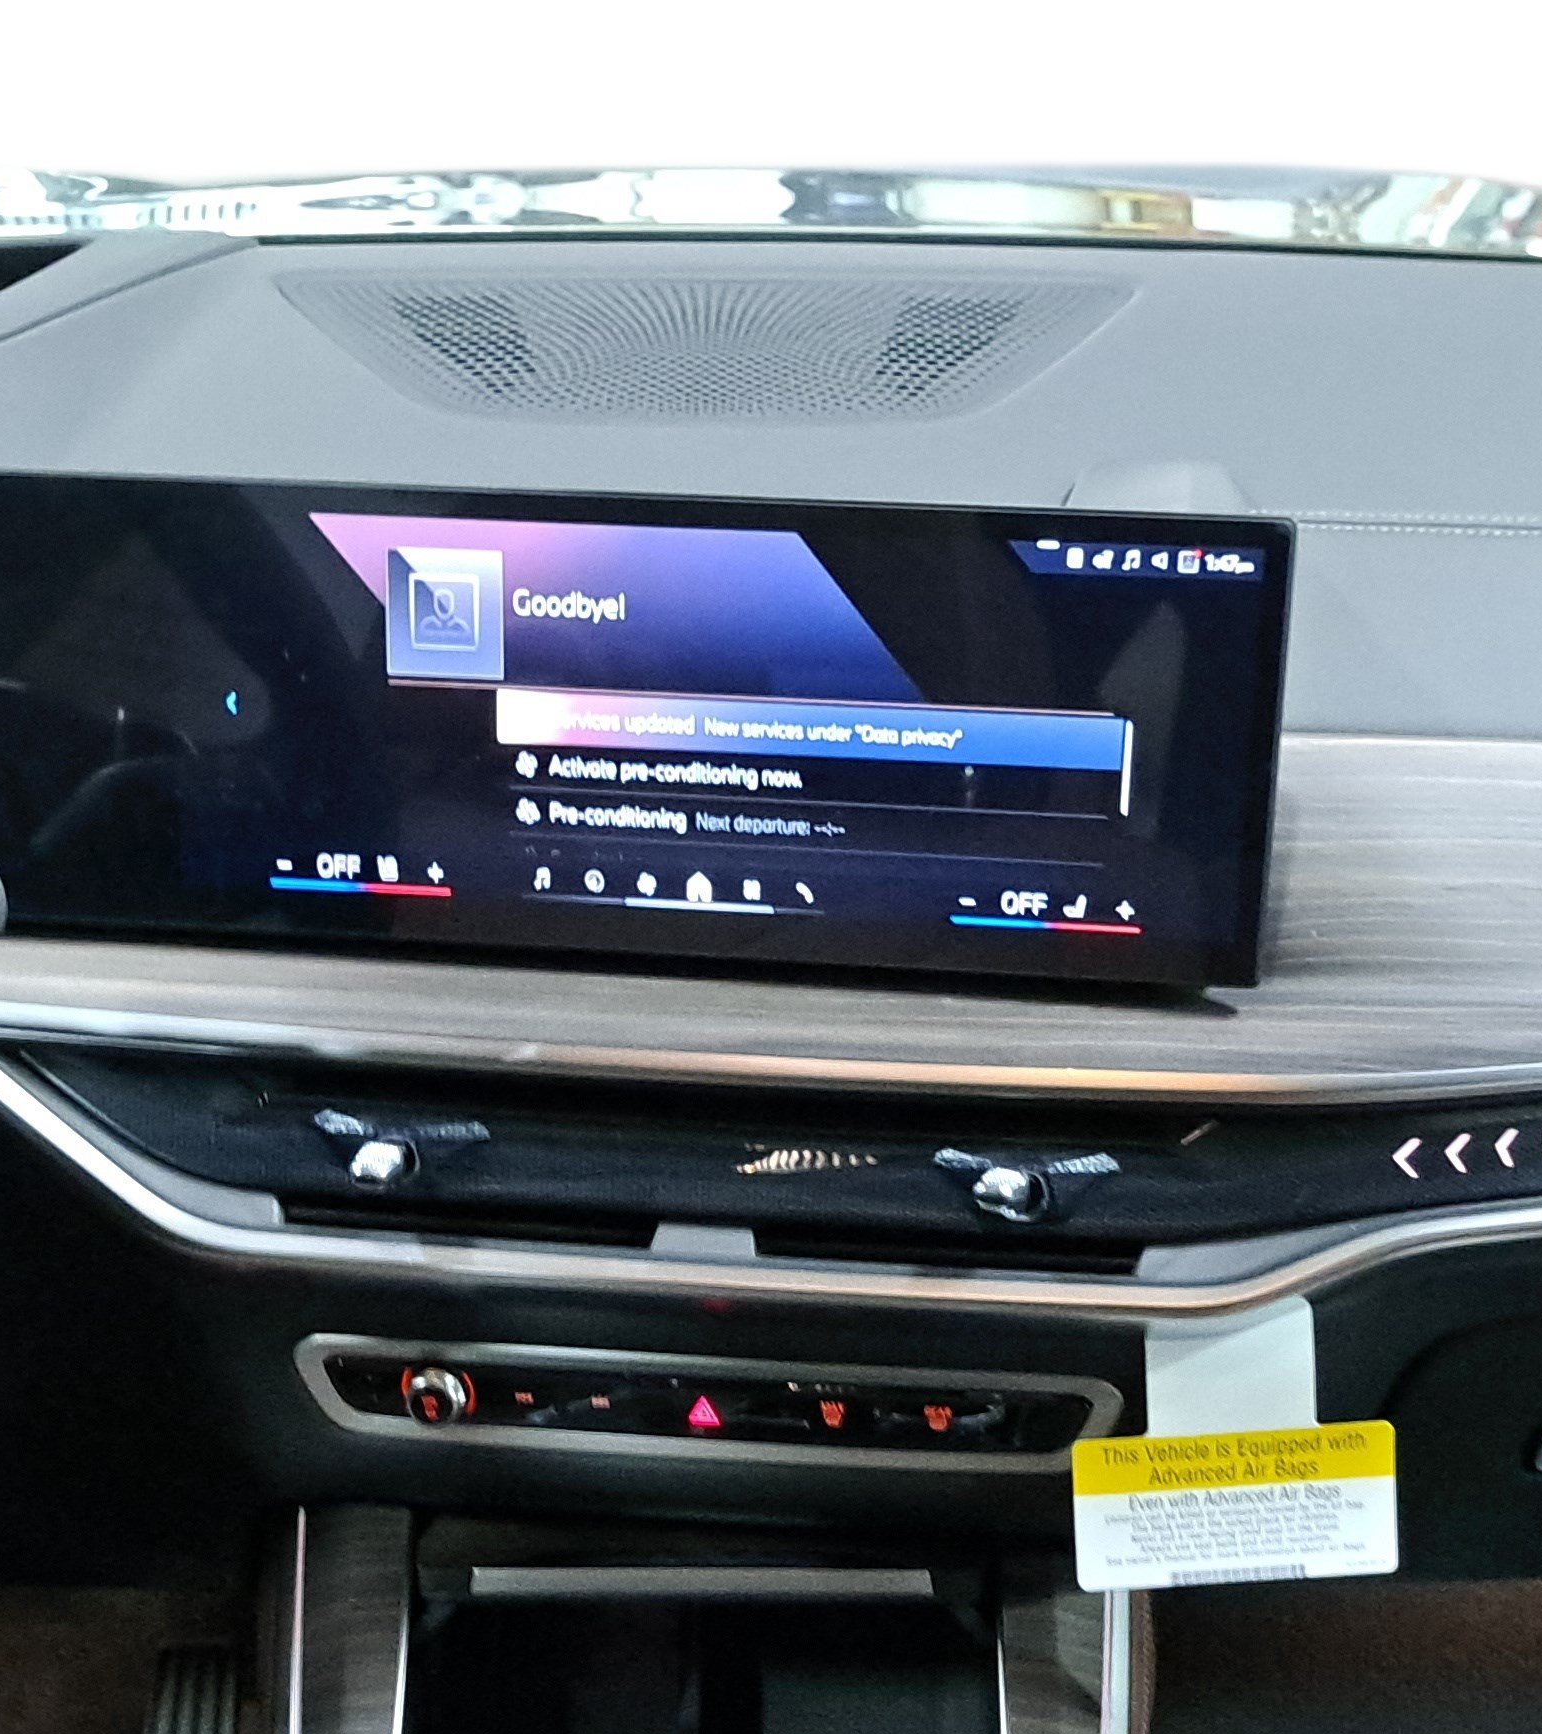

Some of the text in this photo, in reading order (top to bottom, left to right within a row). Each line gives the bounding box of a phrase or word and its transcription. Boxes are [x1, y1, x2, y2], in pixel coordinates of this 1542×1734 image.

[512, 588, 626, 625] Goodbye!
[624, 712, 696, 737] updated
[704, 717, 740, 738] New
[742, 720, 804, 741] services
[807, 723, 852, 743] under
[548, 754, 617, 781] Activate
[619, 761, 760, 791] pre-conditioning
[548, 800, 688, 835] Pre-conditioning
[695, 811, 730, 832] Next
[316, 852, 361, 879] OFF
[1000, 890, 1049, 916] OFF
[1102, 1446, 1139, 1466] This
[1143, 1440, 1210, 1463] Vehicle
[1236, 1434, 1322, 1458] Equipped
[1327, 1431, 1367, 1451] with
[1149, 1457, 1319, 1485] Advanced Air Bags
[1203, 1486, 1274, 1506] Advanced
[1278, 1485, 1300, 1501] Air
[1303, 1483, 1341, 1502] Bags
